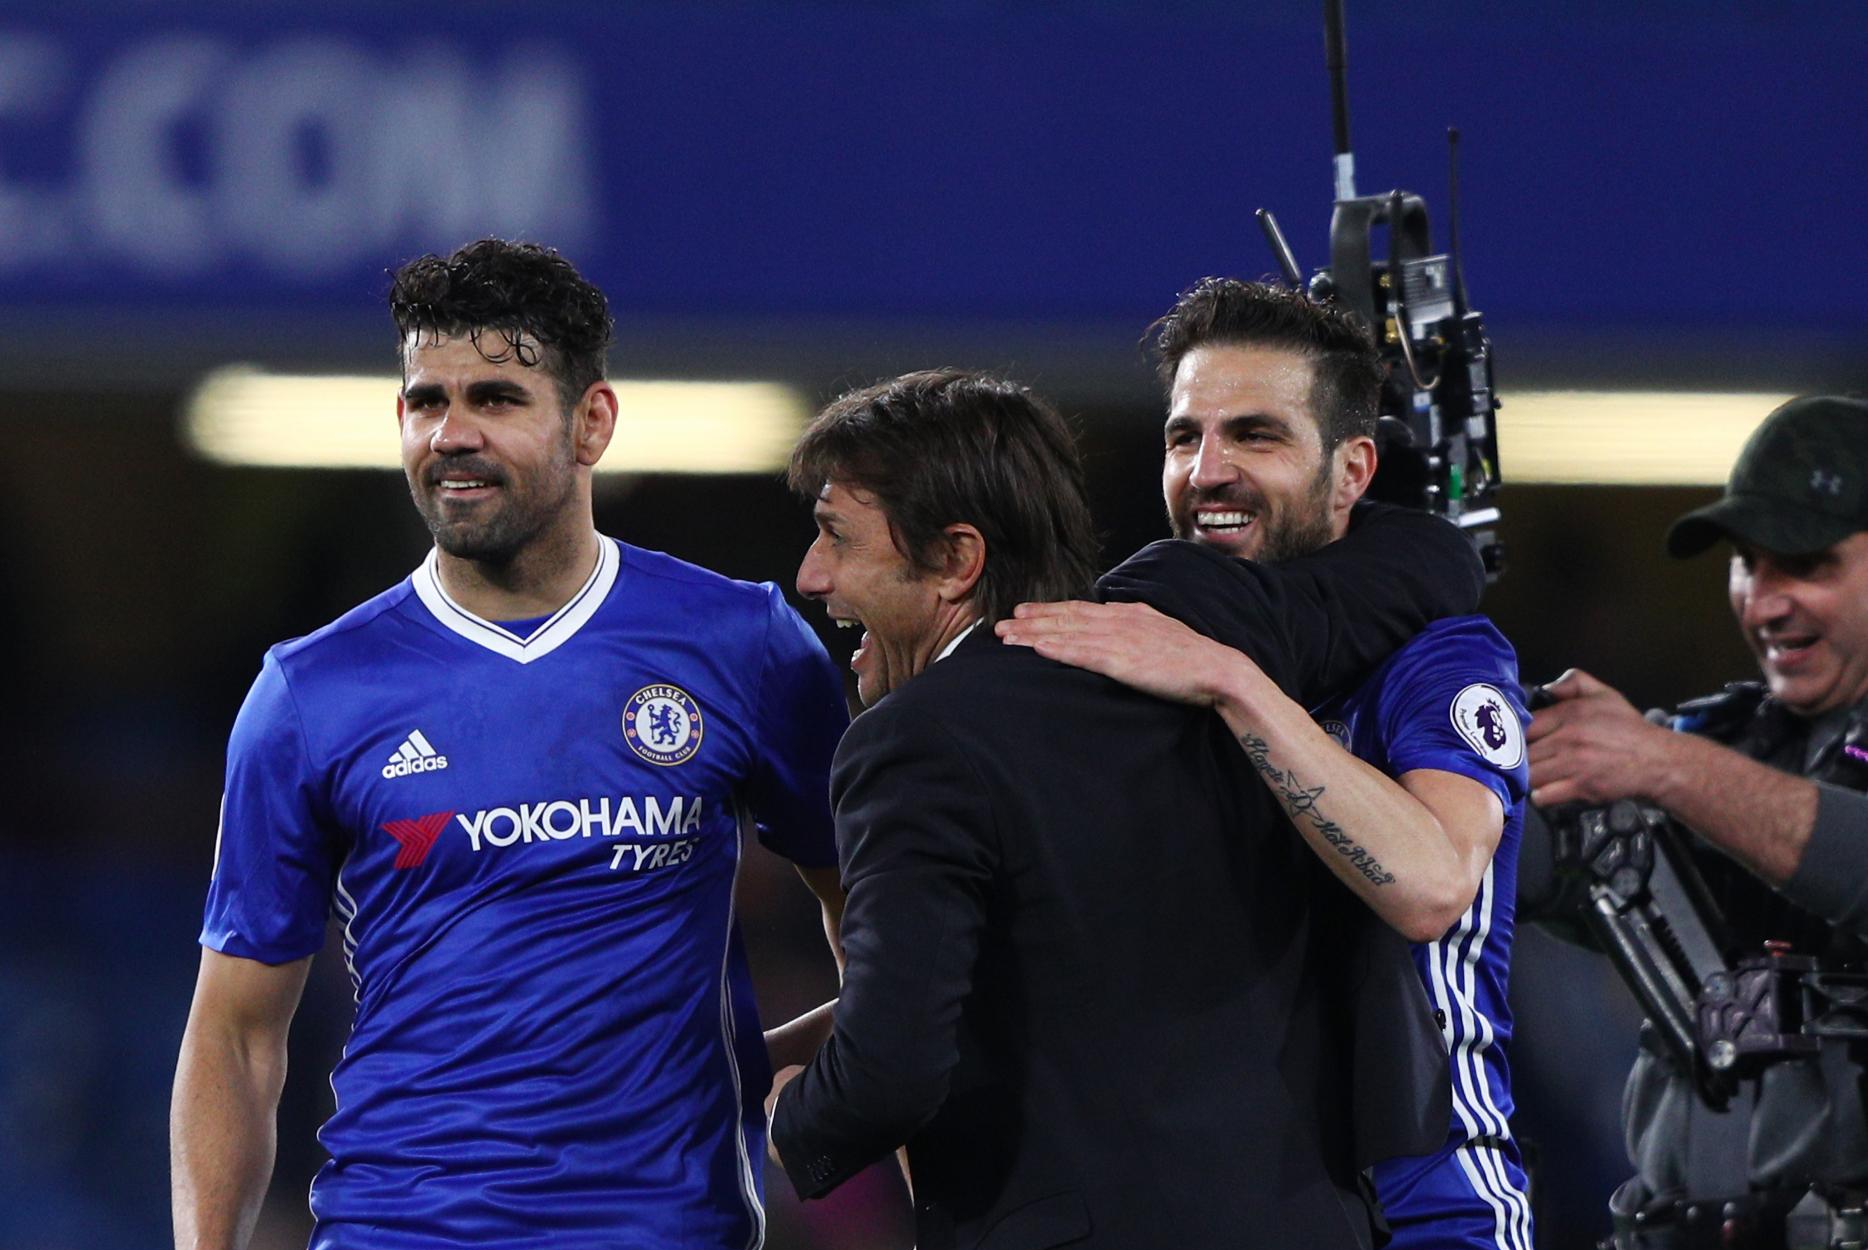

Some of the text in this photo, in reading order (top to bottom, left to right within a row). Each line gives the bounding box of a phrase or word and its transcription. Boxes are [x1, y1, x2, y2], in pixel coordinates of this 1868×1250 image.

[635, 687, 686, 706] CHELSEA
[637, 745, 672, 761] FOOTBALL
[381, 755, 449, 779] adidas
[456, 796, 703, 851] YOKOHAMA
[609, 837, 700, 871] TYRES
